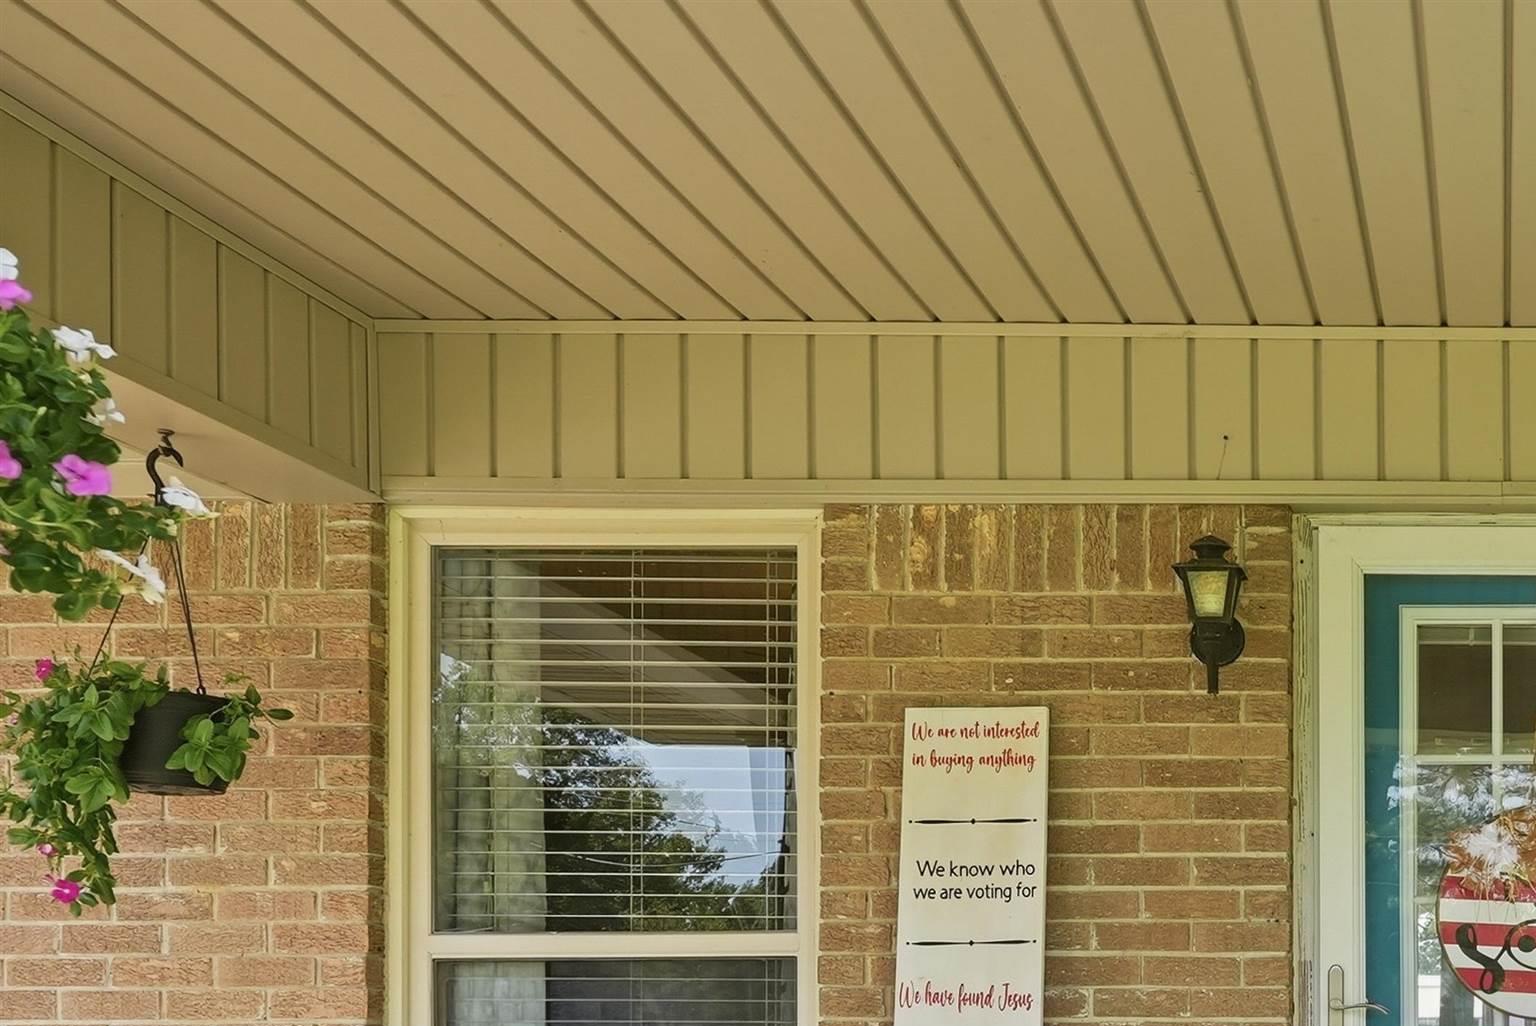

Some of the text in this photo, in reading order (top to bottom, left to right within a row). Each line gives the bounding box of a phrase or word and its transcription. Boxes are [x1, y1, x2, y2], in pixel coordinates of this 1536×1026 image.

[912, 721, 1039, 740] We are not interested
[912, 749, 1036, 773] in buying anything
[916, 860, 1035, 877] We know who
[913, 882, 1036, 902] we are voting for
[899, 981, 1033, 1013] We have found Jesus
